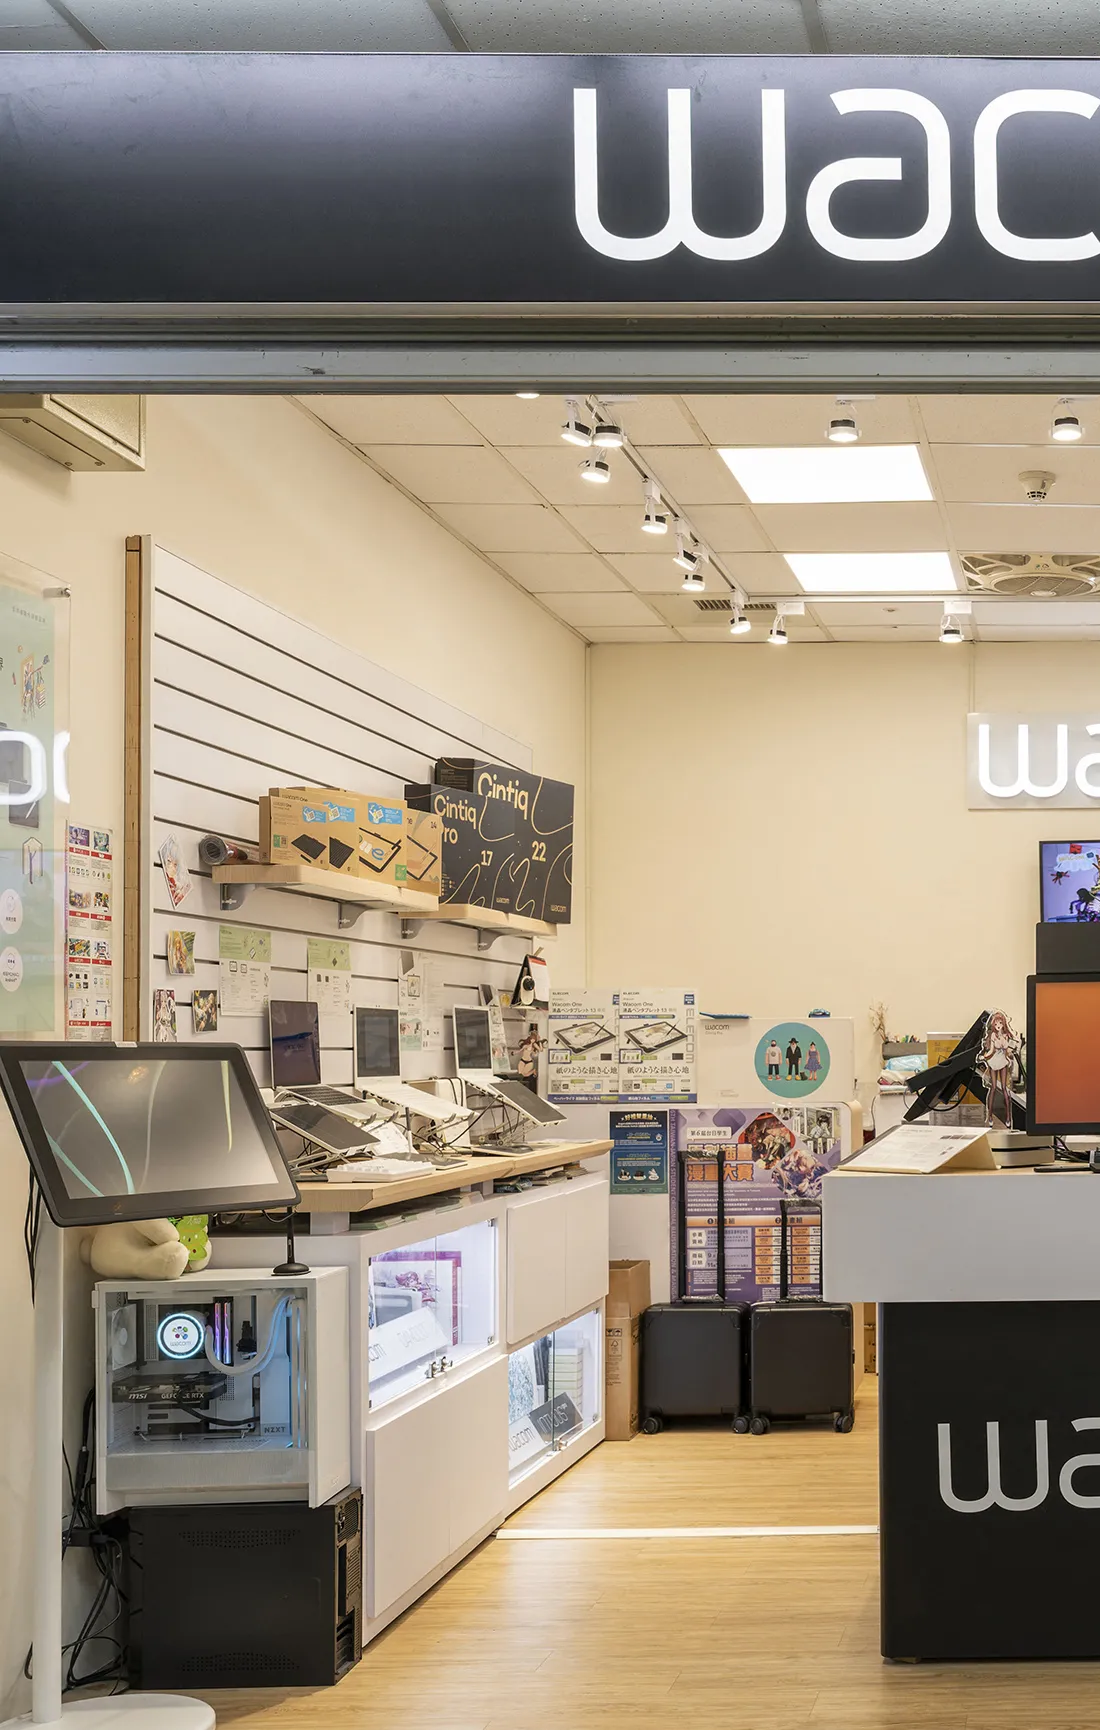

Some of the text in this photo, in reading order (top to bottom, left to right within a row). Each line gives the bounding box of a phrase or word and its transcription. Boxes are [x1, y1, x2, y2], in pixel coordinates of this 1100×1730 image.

[478, 772, 529, 820] Cintiq
[434, 794, 477, 829] Cintiq
[442, 826, 458, 845] ro
[481, 851, 493, 866] 17
[532, 841, 547, 862] 22
[627, 1066, 689, 1074] 紙のような描き心地
[264, 1426, 286, 1434] NZXT
